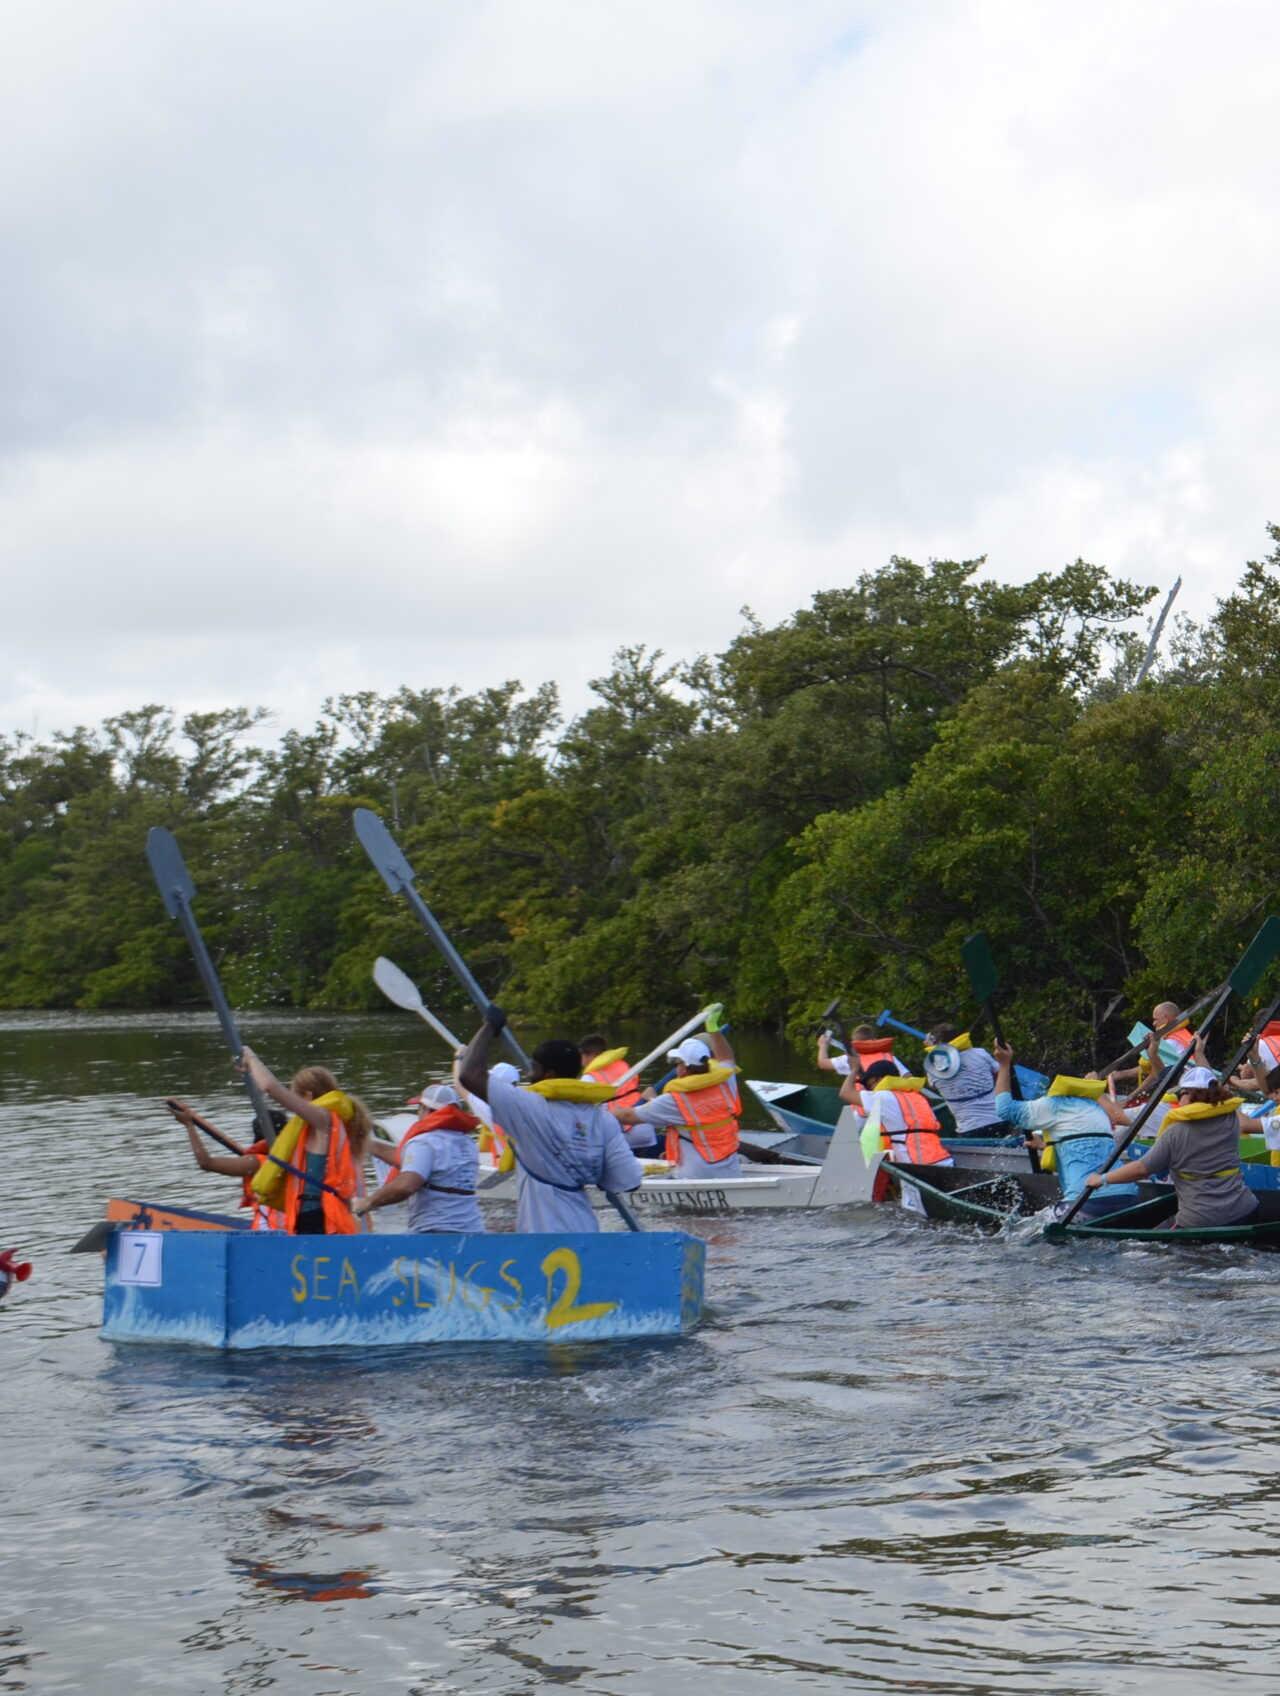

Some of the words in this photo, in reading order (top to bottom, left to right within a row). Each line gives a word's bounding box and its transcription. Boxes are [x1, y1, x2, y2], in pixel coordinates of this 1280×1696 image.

[629, 1189, 730, 1209] CHALLENGER
[134, 1243, 147, 1276] 7
[290, 1254, 361, 1303] SEA
[393, 1257, 524, 1312] SLUGS
[540, 1247, 619, 1329] 2
